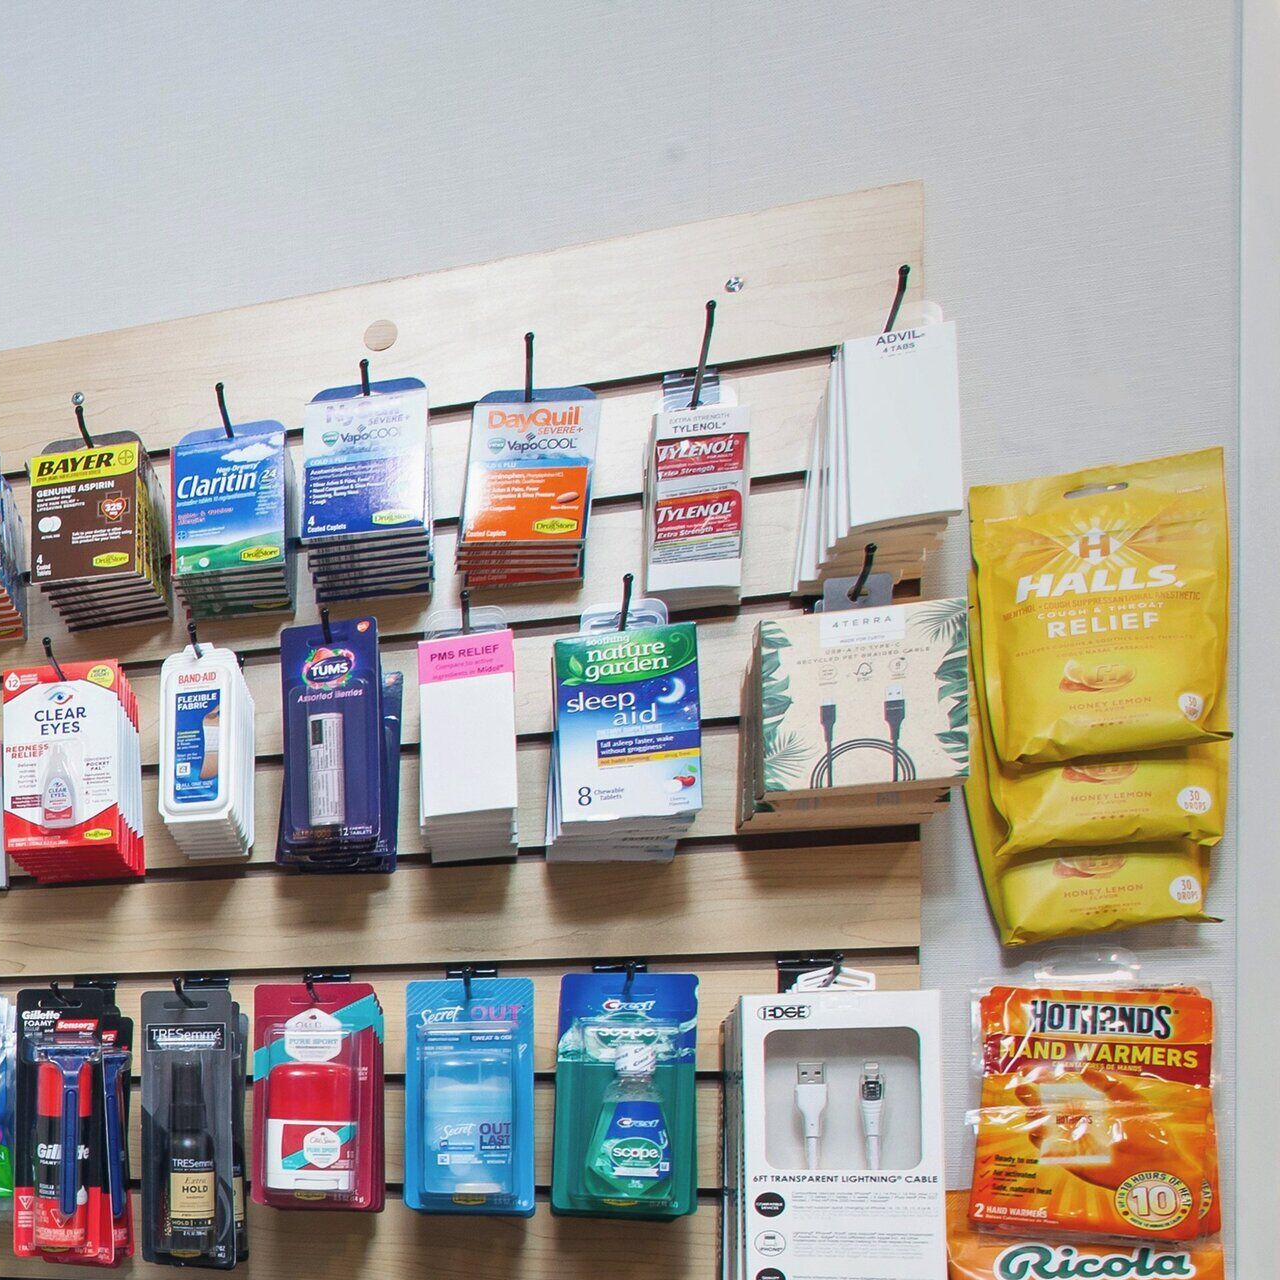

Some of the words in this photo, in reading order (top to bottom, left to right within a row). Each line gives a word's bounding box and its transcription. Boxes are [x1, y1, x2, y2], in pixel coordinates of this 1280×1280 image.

[876, 330, 919, 346] ADVIL
[488, 405, 581, 434] DayQuil
[672, 423, 720, 434] TYLENOL
[507, 436, 577, 452] VapoCOOL
[659, 434, 734, 462] TYLENOL
[37, 451, 114, 477] BAYER
[36, 486, 76, 498] GENUINE
[78, 480, 115, 492] ASPIRIN
[177, 471, 256, 499] Claritin
[105, 502, 122, 511] 325
[656, 504, 731, 525] TYLENOL
[1047, 612, 1160, 638] RELIEF
[430, 651, 455, 662] PMS
[458, 644, 499, 658] RELIEF
[587, 641, 665, 662] nature
[310, 661, 349, 677] TUMS
[585, 657, 669, 682] garden
[177, 672, 217, 685] BAND-AID
[177, 693, 217, 703] FLEXIBLE
[177, 701, 208, 711] FABRIC
[567, 692, 635, 714] sleep
[34, 707, 86, 721] CLEAR
[613, 702, 656, 725] aid
[41, 721, 80, 735] EYES
[577, 786, 592, 806] 8
[594, 787, 624, 795] Chewable
[602, 999, 655, 1012] Crest
[22, 1010, 60, 1020] Gillette
[151, 1027, 221, 1040] TRESemmé
[999, 1042, 1067, 1061] HAND
[1074, 1044, 1198, 1069] WARMERS
[478, 1122, 511, 1135] OUT
[612, 1146, 659, 1161] scope
[181, 1184, 208, 1194] HOLD
[1131, 1185, 1176, 1216] 10
[974, 1203, 984, 1218] 2
[987, 1206, 1007, 1215] HAND
[1009, 1208, 1048, 1218] WARMERS
